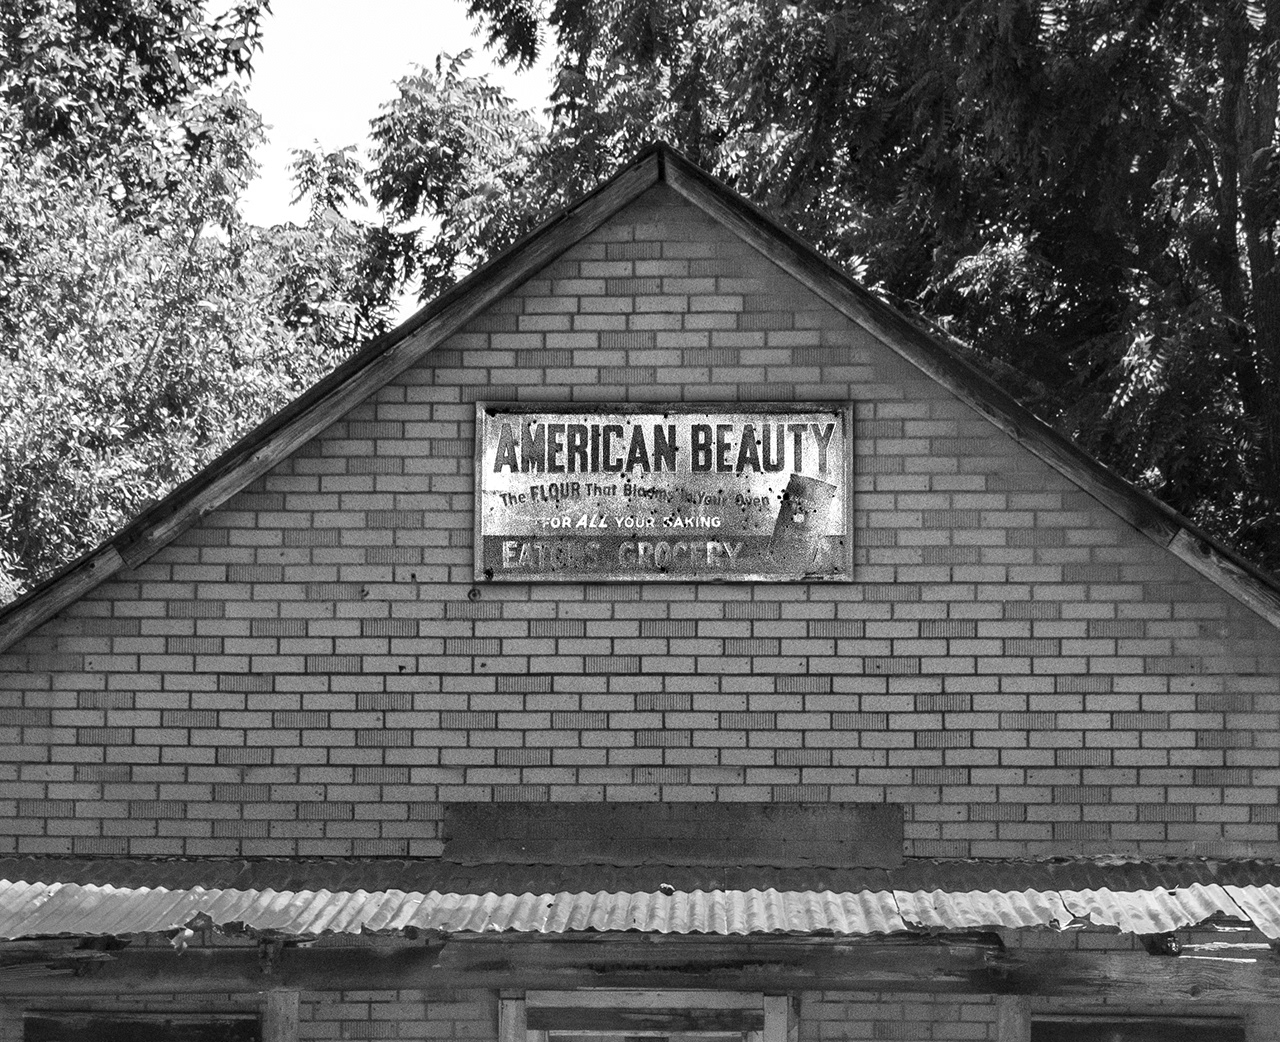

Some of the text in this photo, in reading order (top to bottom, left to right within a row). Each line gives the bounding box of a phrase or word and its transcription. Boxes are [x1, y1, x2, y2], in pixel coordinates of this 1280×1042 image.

[493, 422, 836, 473] AMERICAN BEAUTY
[500, 492, 526, 507] The
[530, 482, 581, 501] FLOUR
[585, 483, 617, 496] That
[735, 493, 770, 507] Oven
[541, 516, 571, 528] FOR
[575, 514, 608, 528] ALL
[615, 516, 655, 528] YOUR
